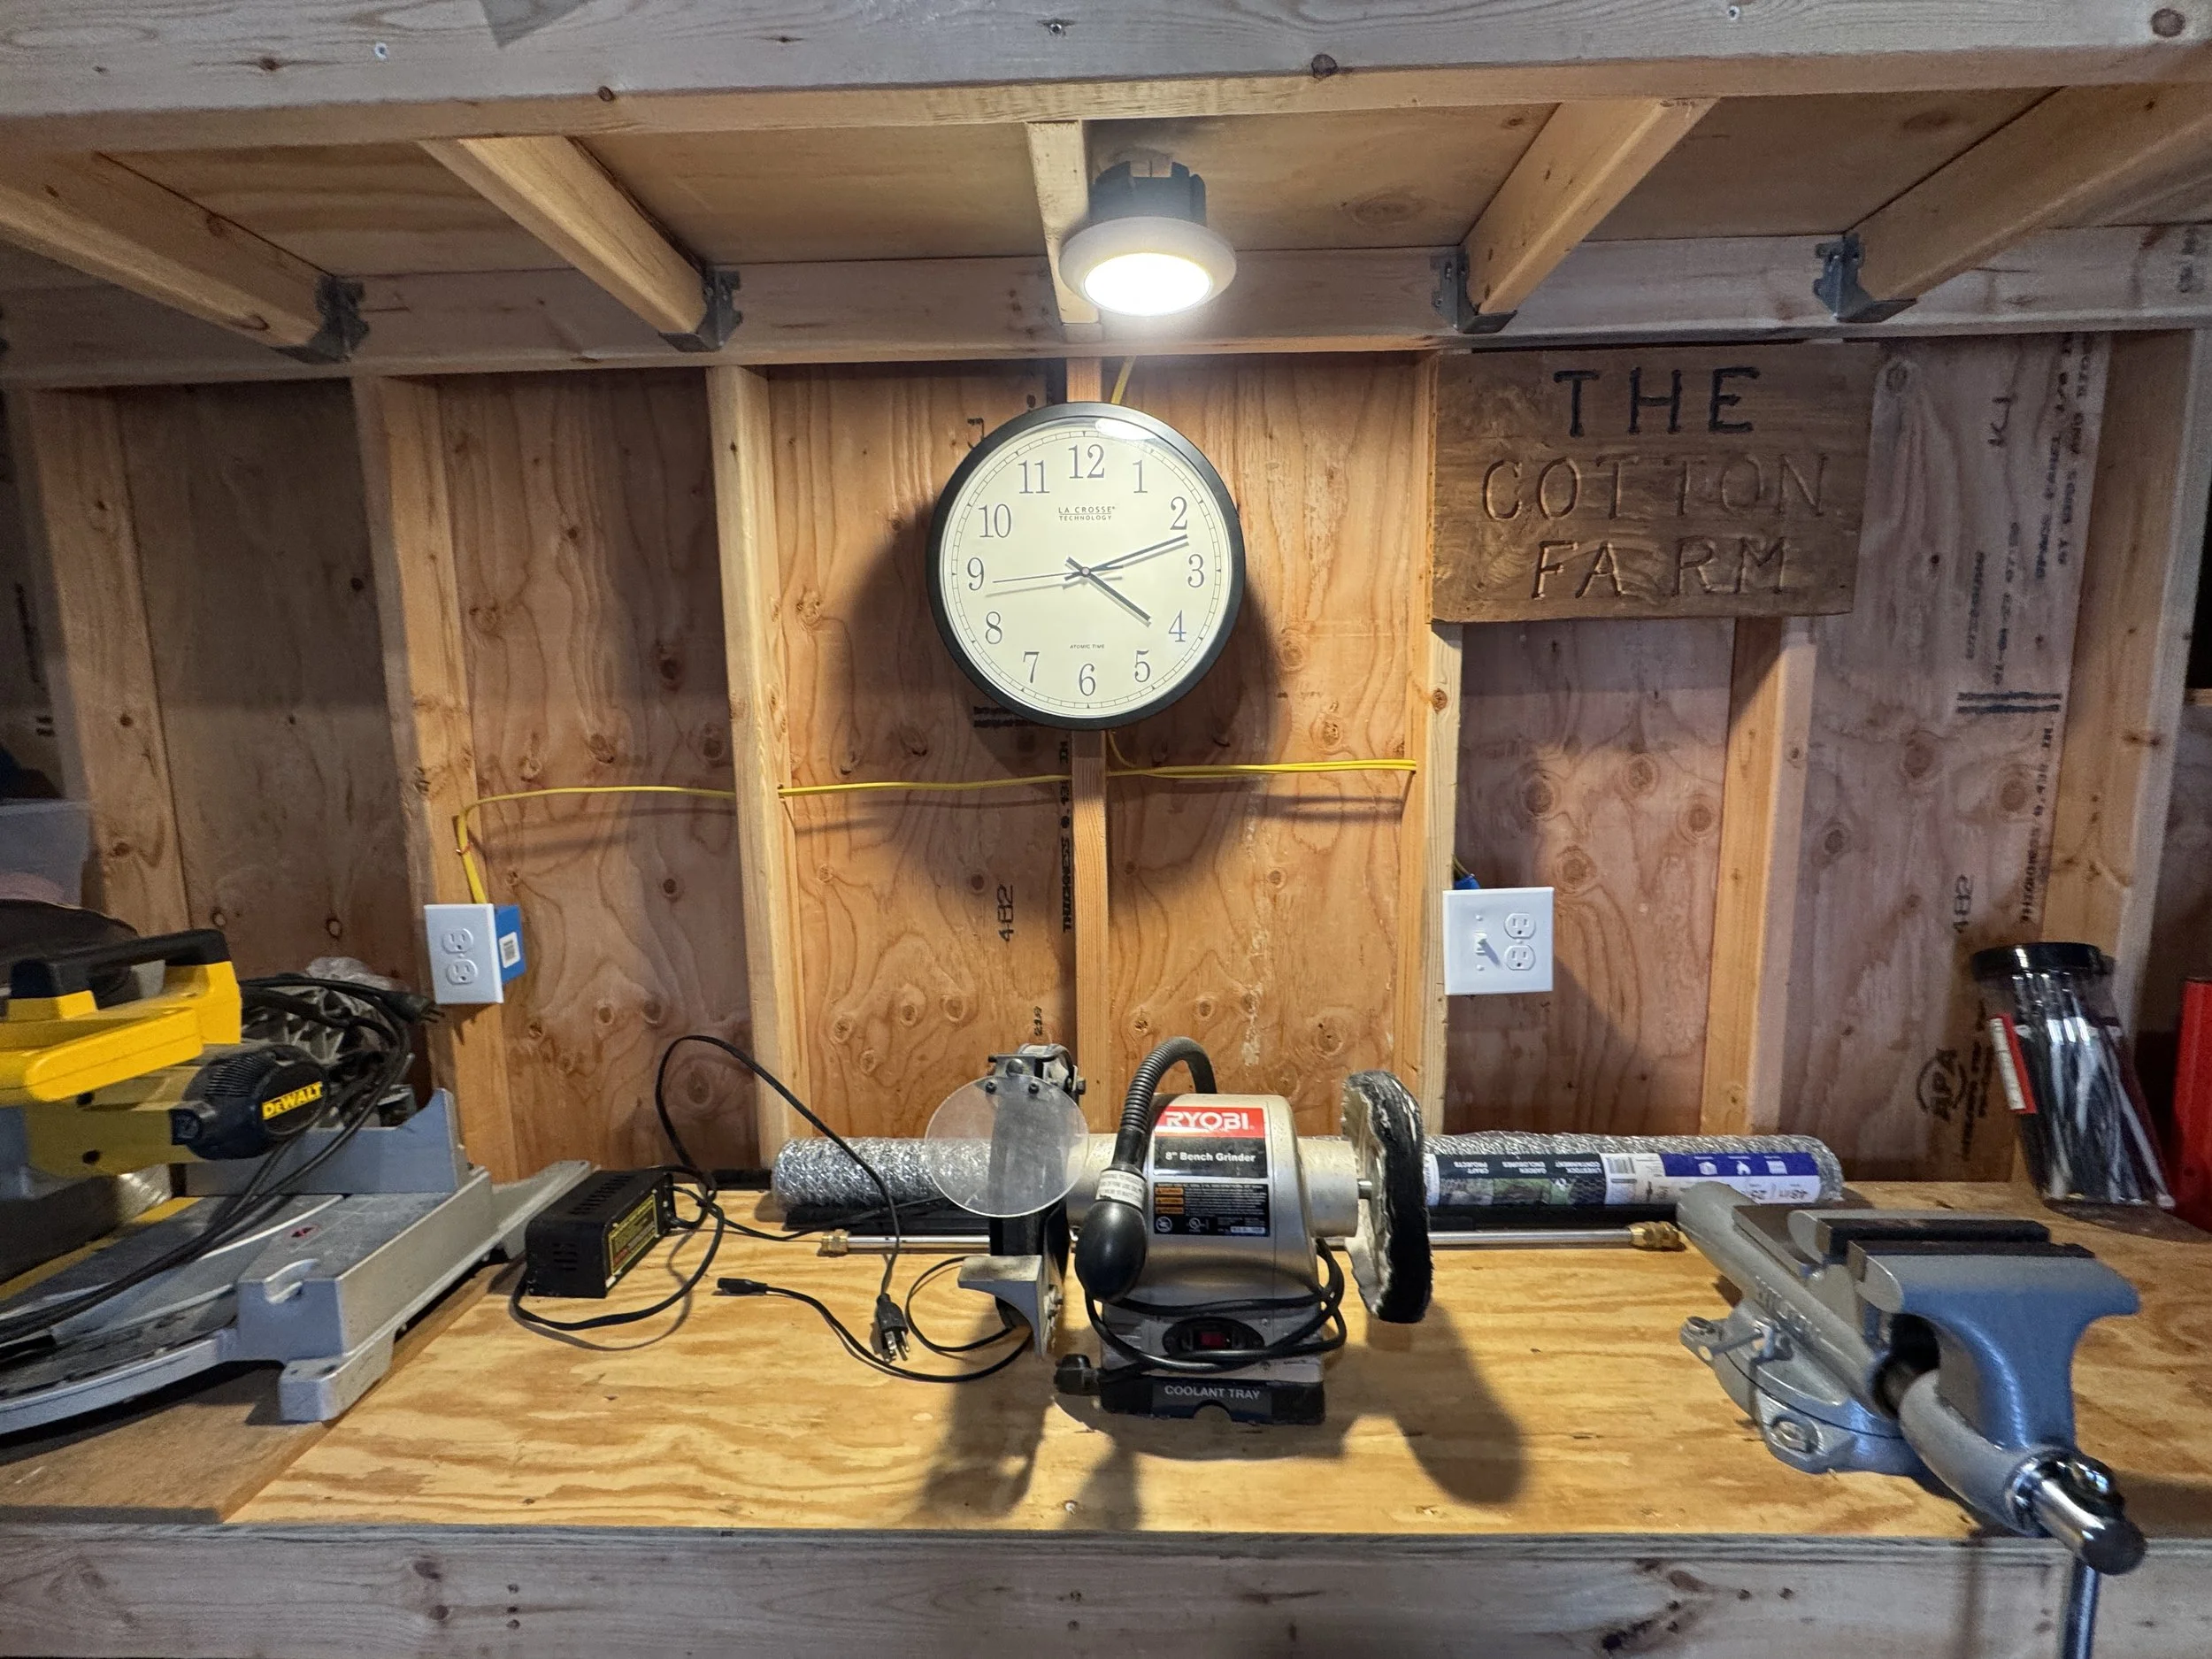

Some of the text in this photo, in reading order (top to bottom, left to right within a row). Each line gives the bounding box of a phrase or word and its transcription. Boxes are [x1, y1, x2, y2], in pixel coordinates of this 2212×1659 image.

[1553, 366, 1761, 438] THE
[1018, 460, 1050, 494] 11
[1068, 443, 1105, 479] 12
[1132, 460, 1148, 494] 1
[1482, 453, 1829, 521] COTTON
[978, 503, 1012, 538] 10
[1170, 496, 1188, 531] 2
[966, 557, 985, 591] 9
[1187, 554, 1205, 588] 3
[1532, 535, 1791, 600] FARM
[985, 611, 1003, 645] 8
[1168, 609, 1187, 642] 4
[1022, 651, 1040, 684] 7
[1079, 664, 1096, 696] 6
[1134, 649, 1151, 683] 5
[996, 884, 1015, 942] 482
[1164, 1111, 1249, 1132] RYOBI
[1165, 1151, 1256, 1163] 8" Bench Grinder
[1164, 1385, 1260, 1400] COOLANT TRAY
